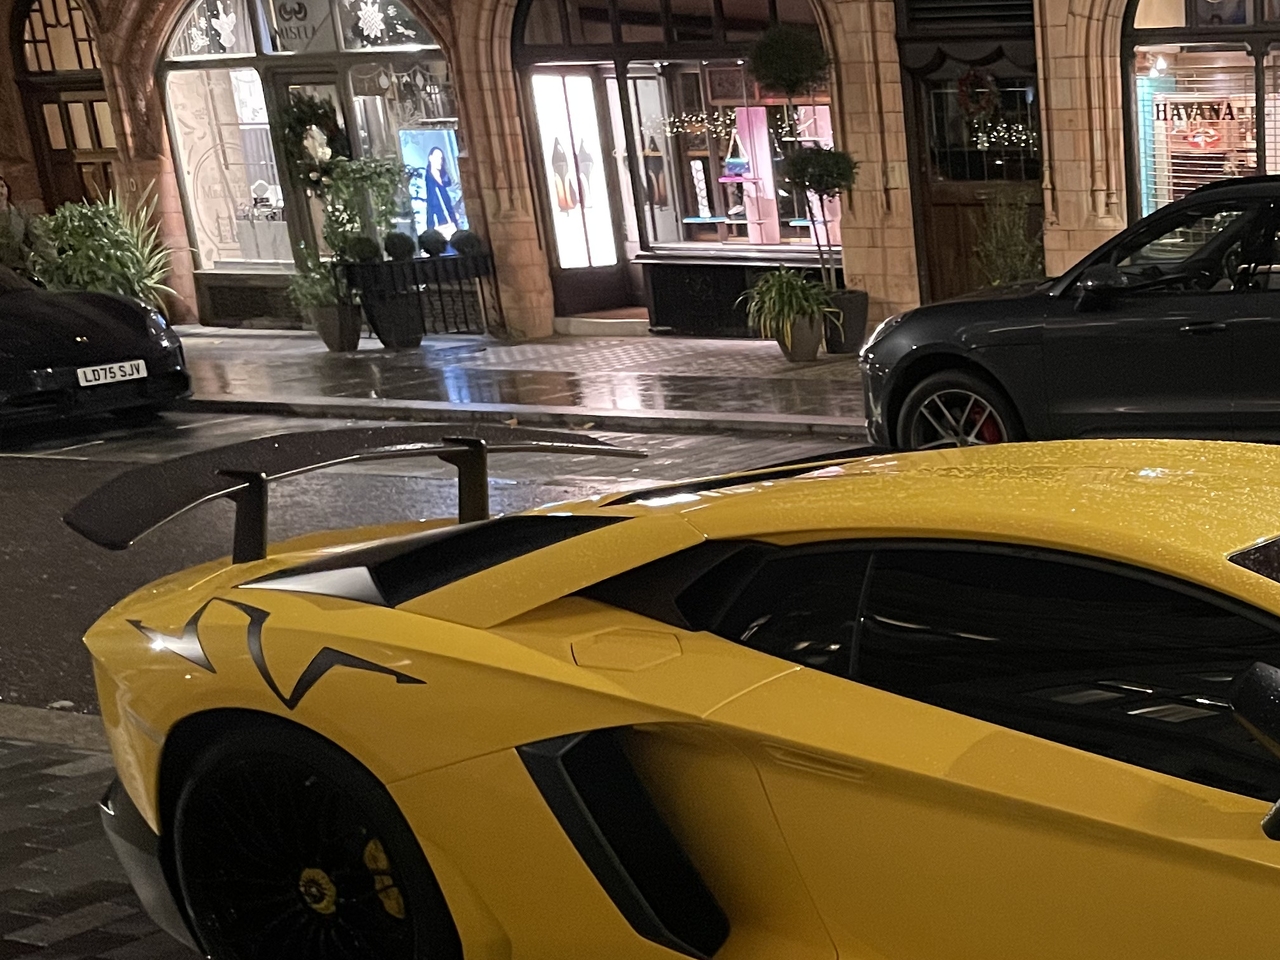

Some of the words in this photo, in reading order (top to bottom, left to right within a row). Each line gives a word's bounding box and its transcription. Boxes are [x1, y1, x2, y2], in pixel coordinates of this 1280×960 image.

[1155, 103, 1236, 121] HAVANA
[83, 367, 117, 383] LD75
[118, 363, 140, 378] SJV
